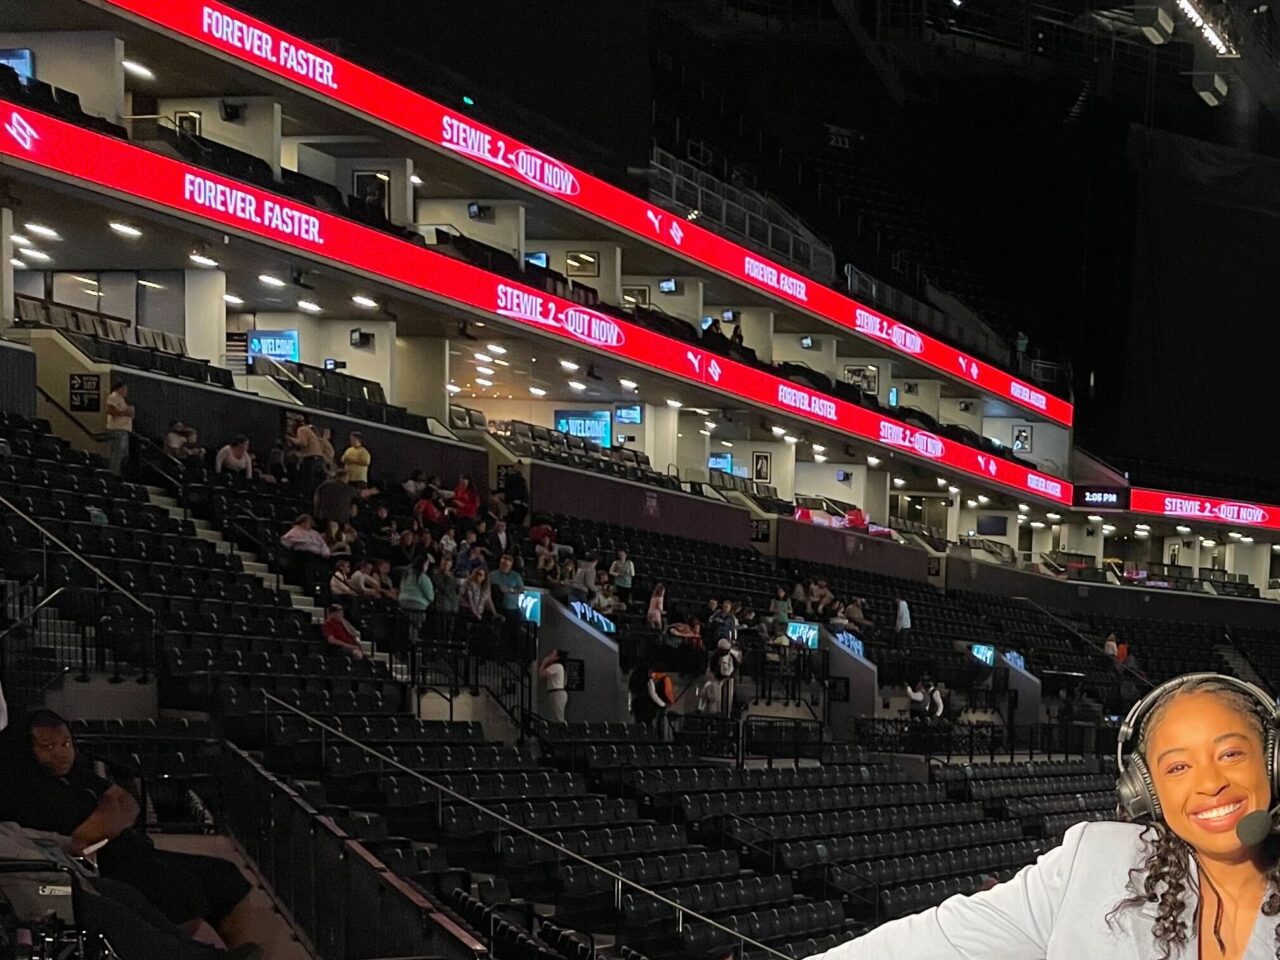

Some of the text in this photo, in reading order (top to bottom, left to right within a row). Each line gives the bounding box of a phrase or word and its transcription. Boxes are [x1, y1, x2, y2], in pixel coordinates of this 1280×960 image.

[203, 6, 338, 90] FOREVER. FASTER.
[442, 115, 493, 158] STEWIE
[518, 150, 542, 180] OUT
[544, 162, 574, 194] NOW
[184, 173, 324, 244] FOREVER. FASTER.
[497, 284, 544, 320] STEWIE
[567, 310, 589, 336] OUT
[591, 319, 619, 345] NOW
[568, 419, 607, 437] WELCOME
[1164, 497, 1201, 513] STEWIE
[1220, 504, 1239, 519] OUT
[1240, 507, 1263, 522] NOW
